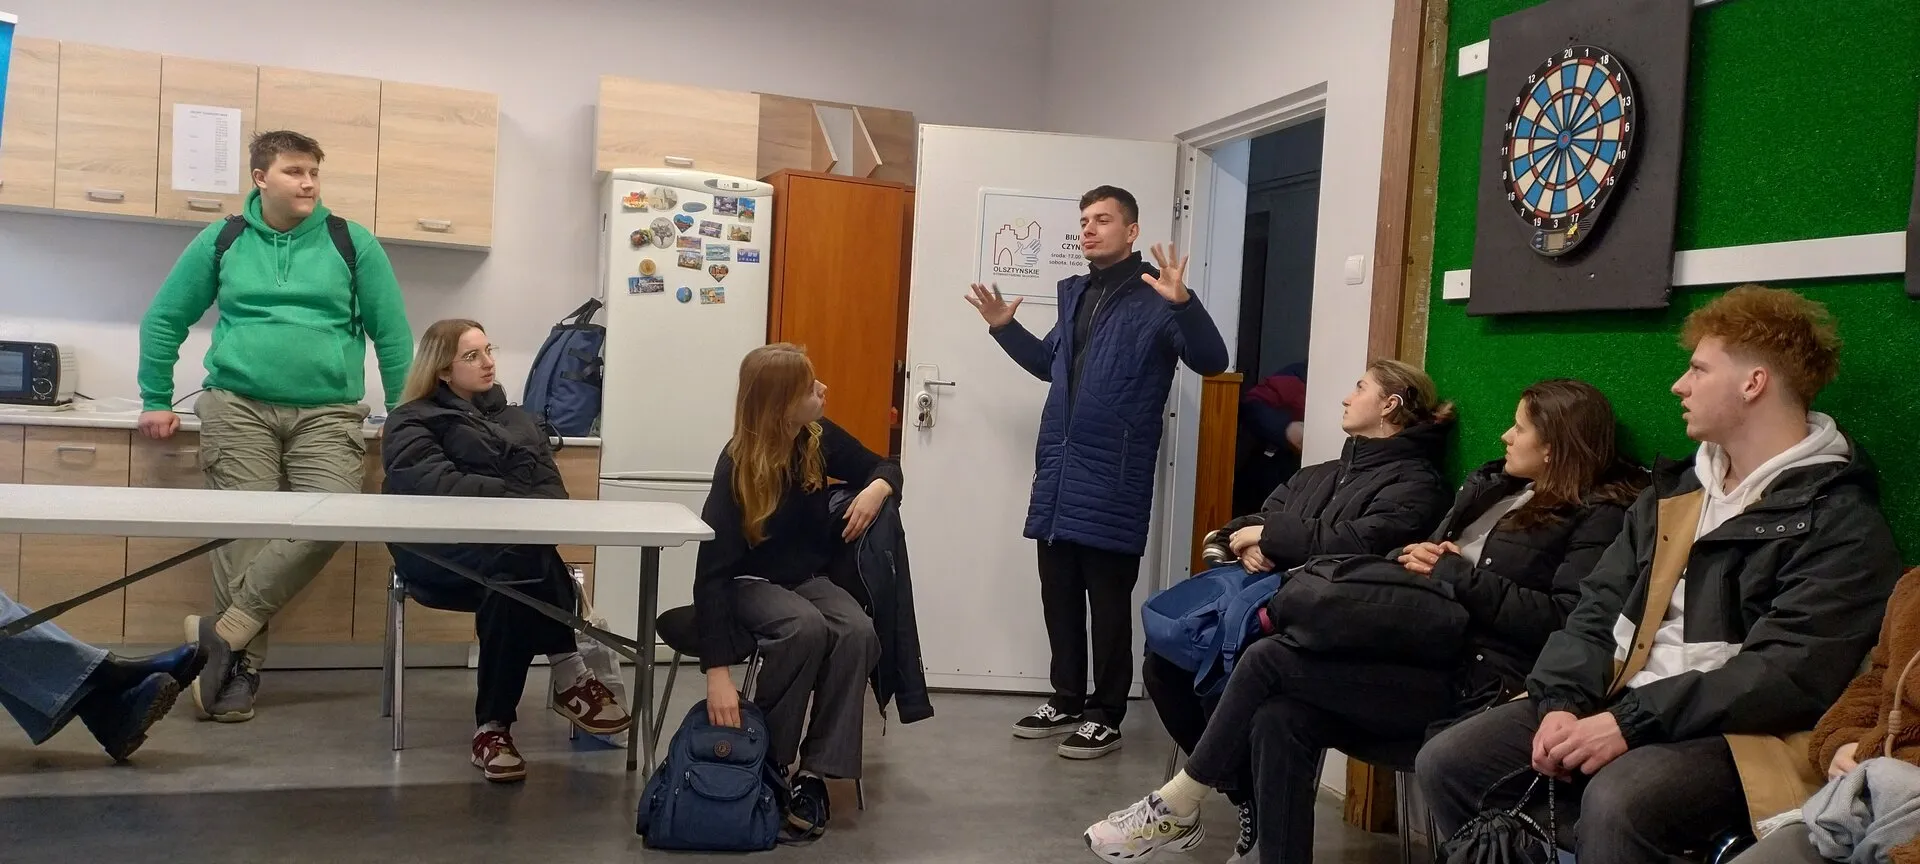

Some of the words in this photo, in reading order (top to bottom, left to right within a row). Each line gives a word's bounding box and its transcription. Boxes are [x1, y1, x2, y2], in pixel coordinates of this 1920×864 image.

[1563, 48, 1573, 58] 20
[1585, 48, 1589, 57] 1
[1547, 58, 1552, 67] 5
[1600, 54, 1609, 64] 18
[1528, 74, 1536, 83] 12
[1616, 72, 1621, 82] 4
[1515, 96, 1521, 106] 9
[1623, 96, 1631, 106] 13
[1505, 122, 1512, 131] 14
[1625, 122, 1630, 132] 6
[1501, 146, 1508, 155] 11
[1618, 150, 1626, 159] 10
[1503, 170, 1507, 180] 8
[1606, 176, 1615, 186] 15
[1507, 191, 1515, 201] 16
[1590, 199, 1596, 209] 2
[1521, 208, 1525, 217] 7
[1533, 217, 1542, 227] 19
[1571, 213, 1579, 223] 17
[1554, 219, 1558, 228] 3
